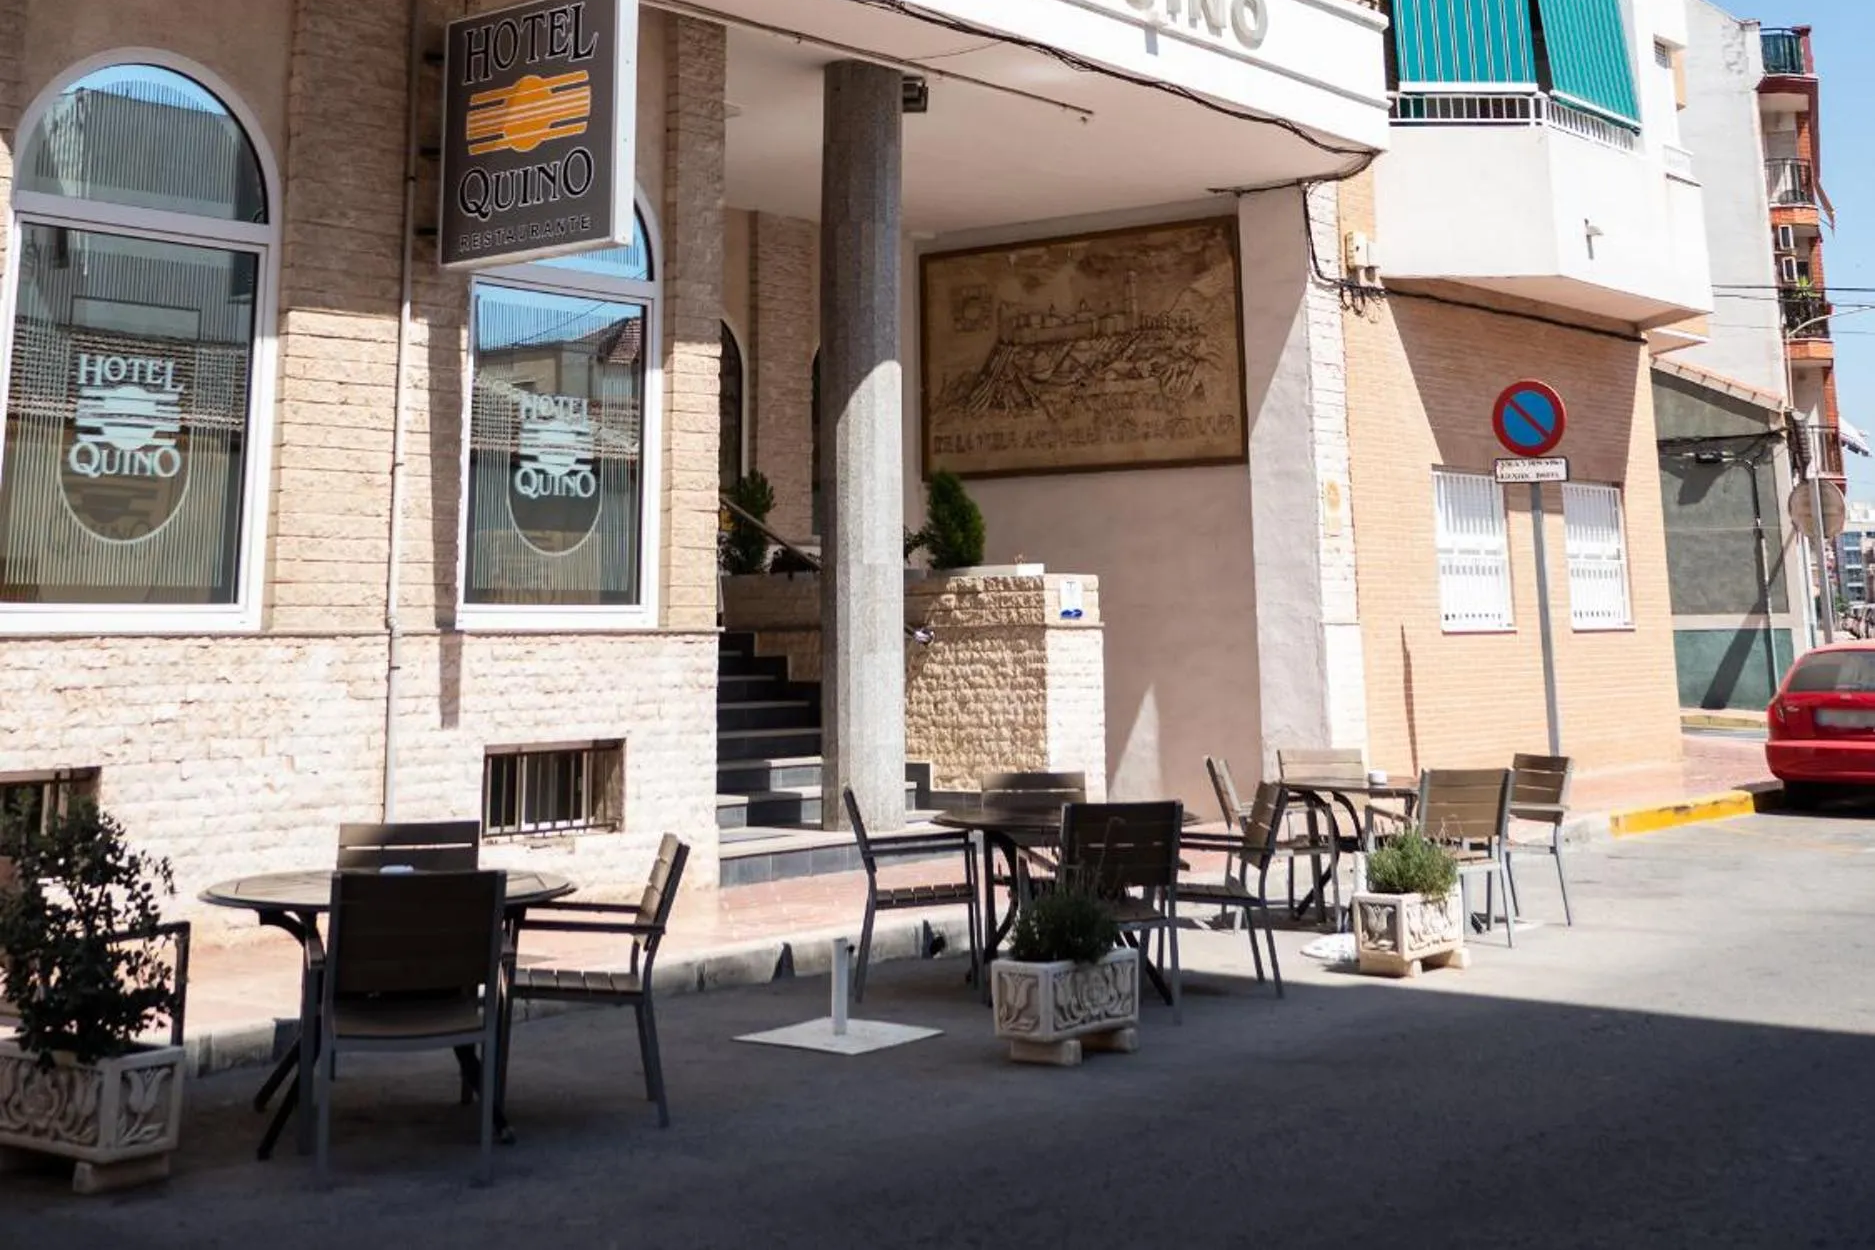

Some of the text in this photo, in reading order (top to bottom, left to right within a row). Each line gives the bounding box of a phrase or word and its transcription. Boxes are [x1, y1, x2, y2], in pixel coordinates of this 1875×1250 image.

[462, 1, 598, 85] HOTEL
[459, 147, 594, 221] QUINO
[459, 215, 591, 252] RESTAURANTE
[78, 353, 184, 392] HOTEL
[519, 394, 591, 428] HOTEL
[68, 441, 181, 478] QUINO
[514, 467, 596, 499] QUINO
